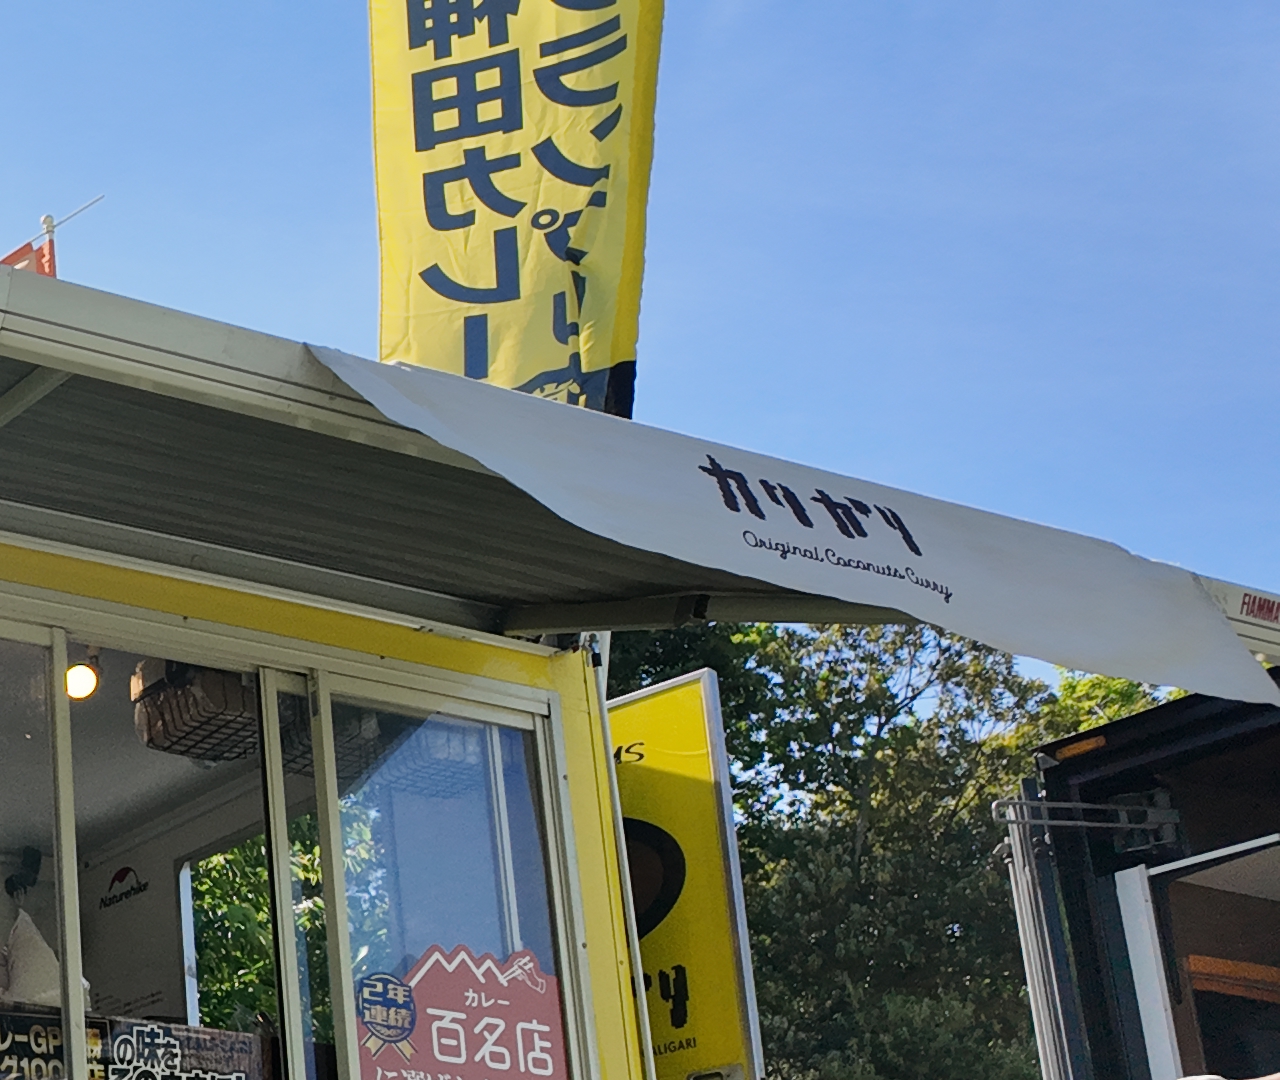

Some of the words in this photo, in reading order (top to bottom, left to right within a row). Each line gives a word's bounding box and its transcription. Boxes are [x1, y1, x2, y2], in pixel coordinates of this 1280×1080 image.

[742, 530, 824, 563] Original
[824, 548, 906, 580] Coconuts
[905, 566, 953, 603] Curry
[98, 880, 150, 910] Naturehike
[362, 979, 411, 1004] 2年
[464, 988, 510, 1008] カレー
[363, 1003, 413, 1029] 連続
[113, 1024, 181, 1072] の味を
[426, 1007, 554, 1076] 百名店
